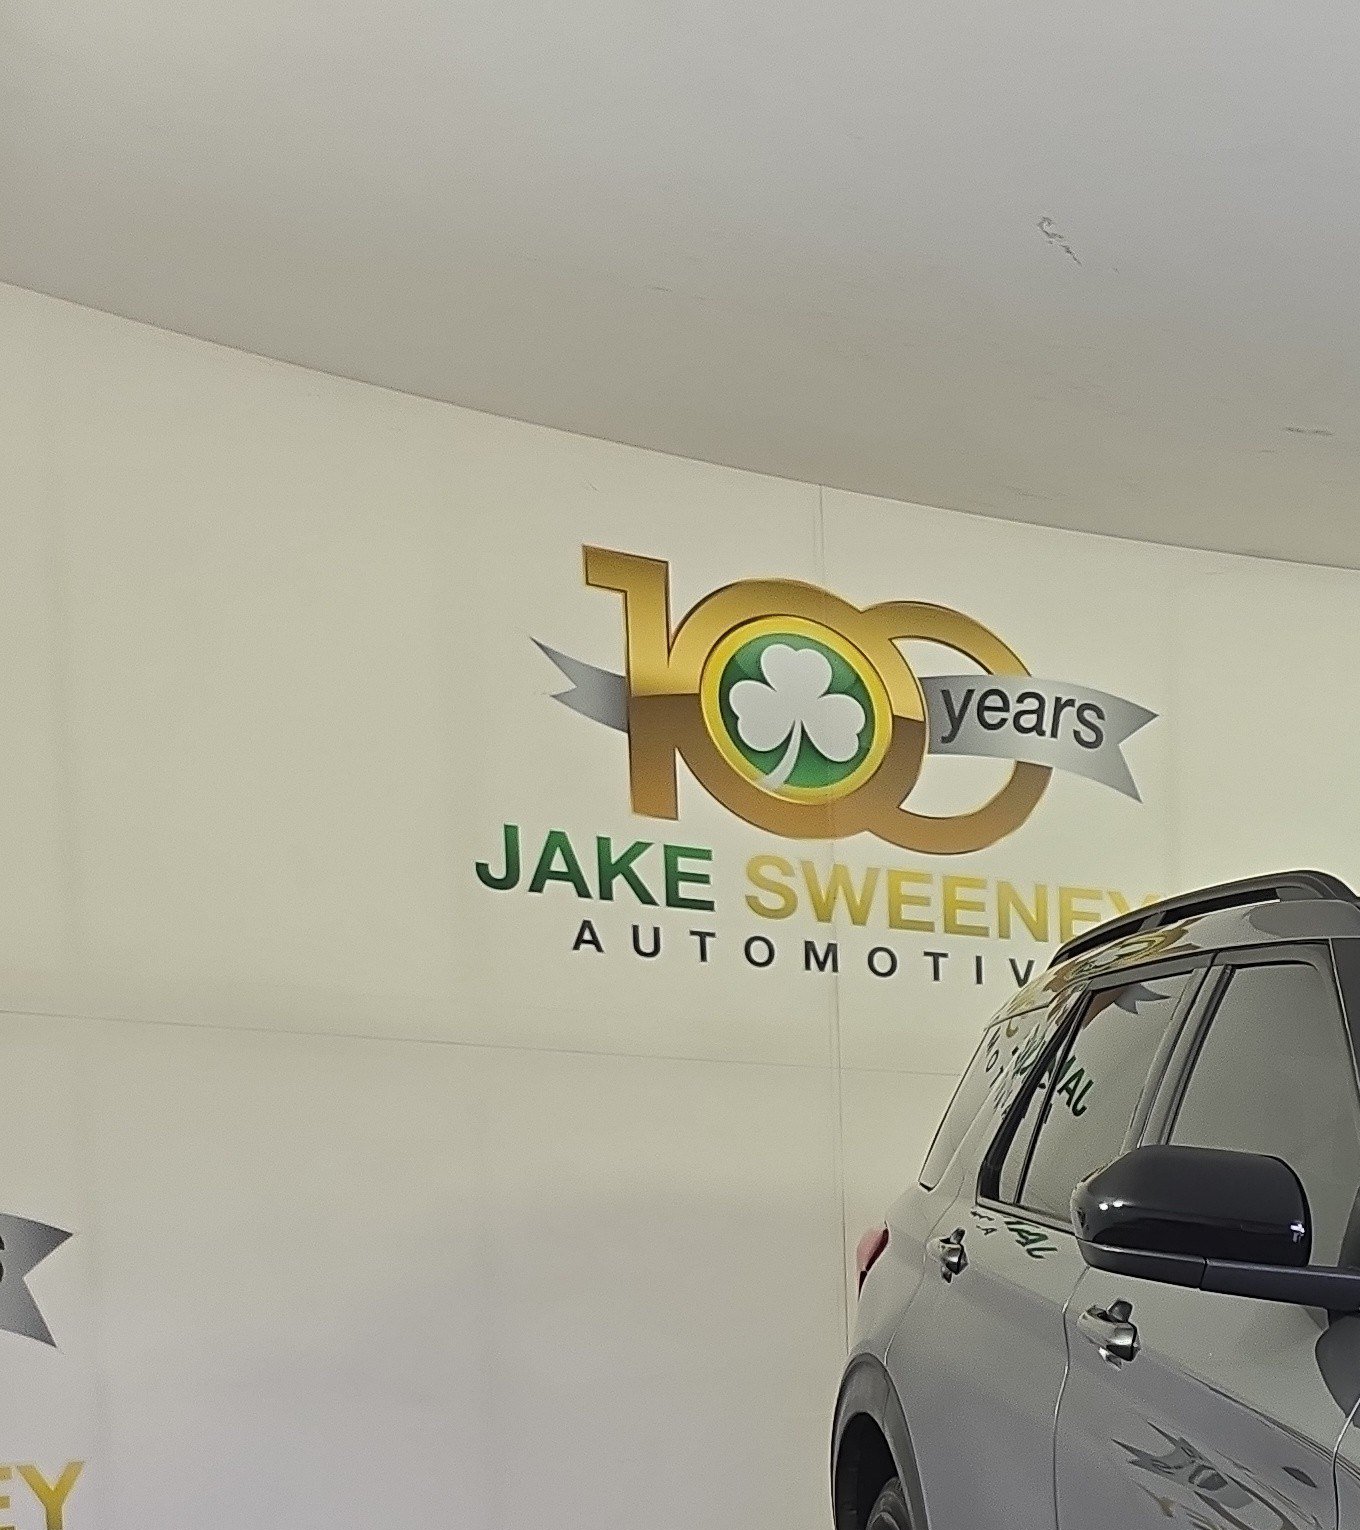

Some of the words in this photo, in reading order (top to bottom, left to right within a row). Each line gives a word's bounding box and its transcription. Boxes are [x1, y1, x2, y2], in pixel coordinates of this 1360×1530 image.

[583, 545, 1053, 855] 100
[939, 679, 1106, 750] years
[474, 823, 715, 912] JAKE
[571, 919, 1036, 989] AUTOMOTIV
